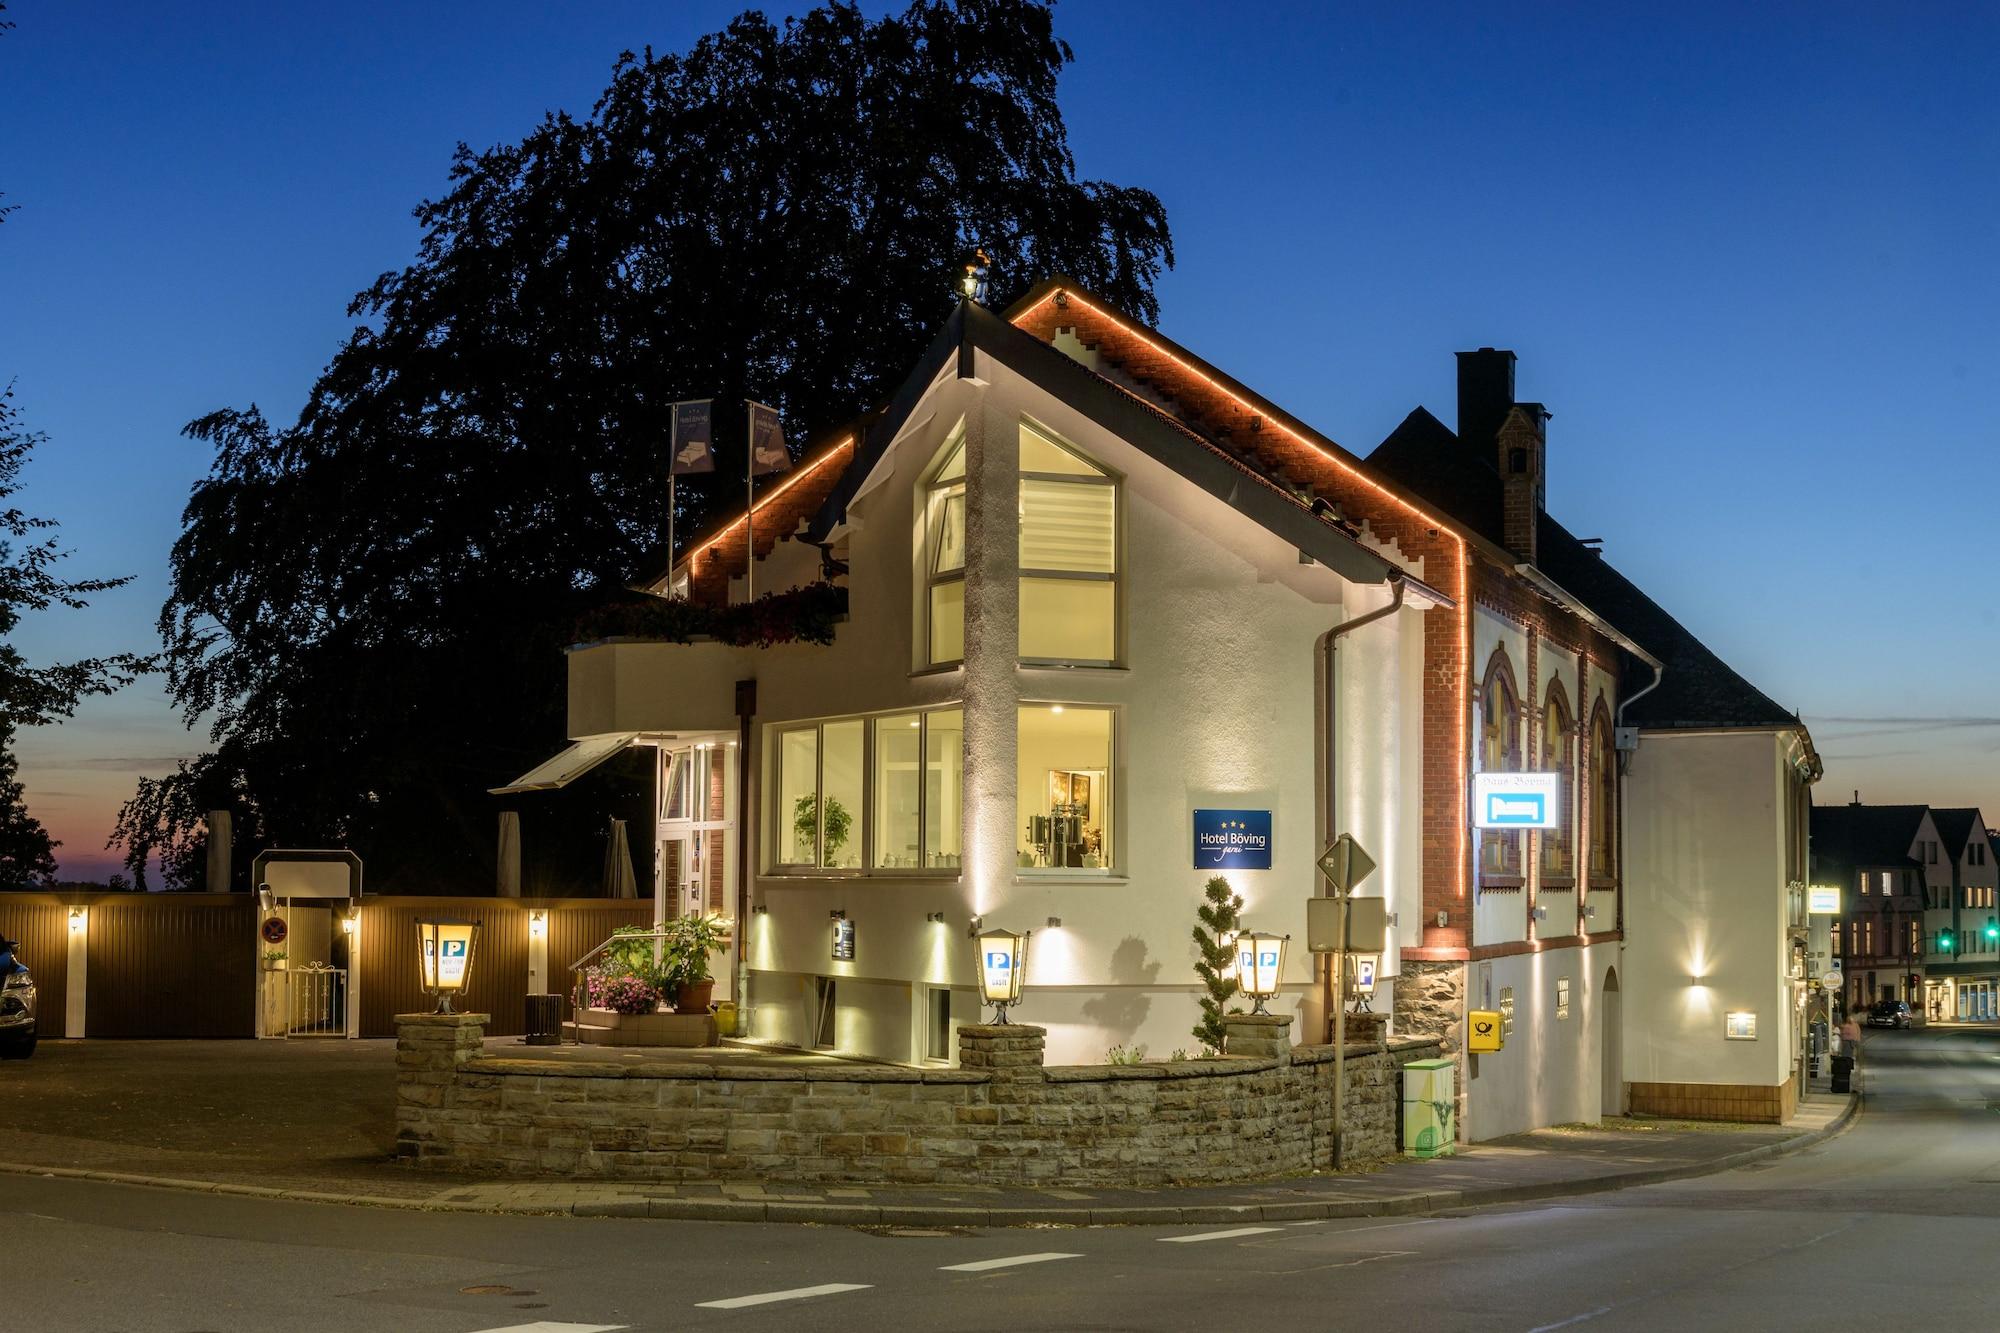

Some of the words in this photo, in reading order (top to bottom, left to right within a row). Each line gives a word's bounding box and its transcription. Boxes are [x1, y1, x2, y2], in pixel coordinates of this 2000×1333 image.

[1200, 833, 1228, 844] Hotel
[1230, 833, 1266, 847] Böving
[1214, 845, 1243, 862] garni
[447, 941, 462, 957] P
[992, 953, 1006, 968] P
[1263, 953, 1275, 966] P
[1360, 962, 1373, 984] P
